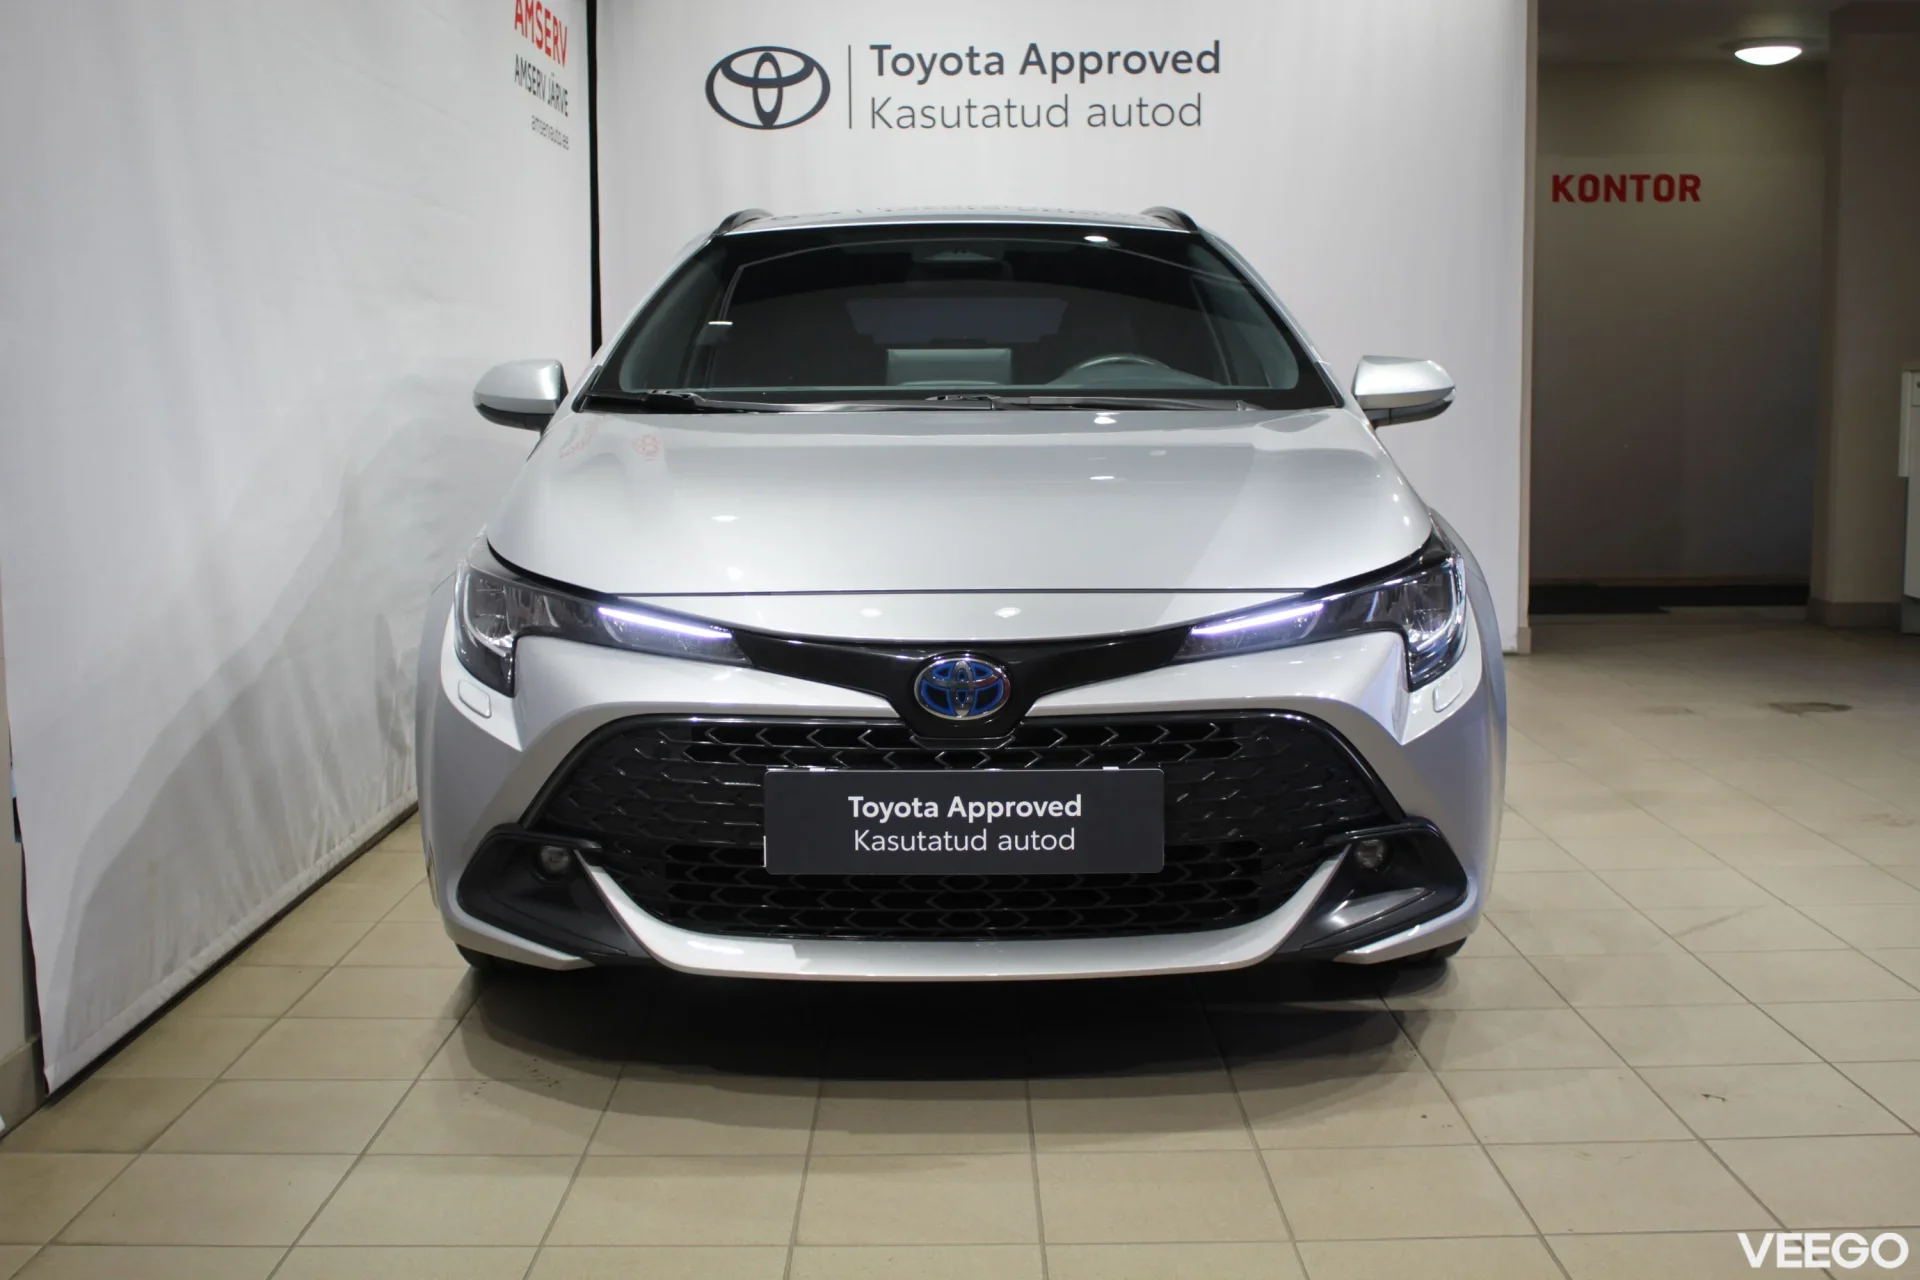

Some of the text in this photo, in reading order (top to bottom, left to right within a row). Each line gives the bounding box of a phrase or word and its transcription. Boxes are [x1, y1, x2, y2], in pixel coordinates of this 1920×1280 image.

[514, 0, 568, 68] AMSERV
[514, 54, 547, 102] AMSERV
[870, 40, 1220, 85] Toyota Approved
[871, 92, 1203, 129] Kasutatud autod
[1553, 174, 1701, 203] KONTOR
[848, 794, 1082, 823] Toyota Approved
[854, 827, 1075, 852] Kasutatud autod
